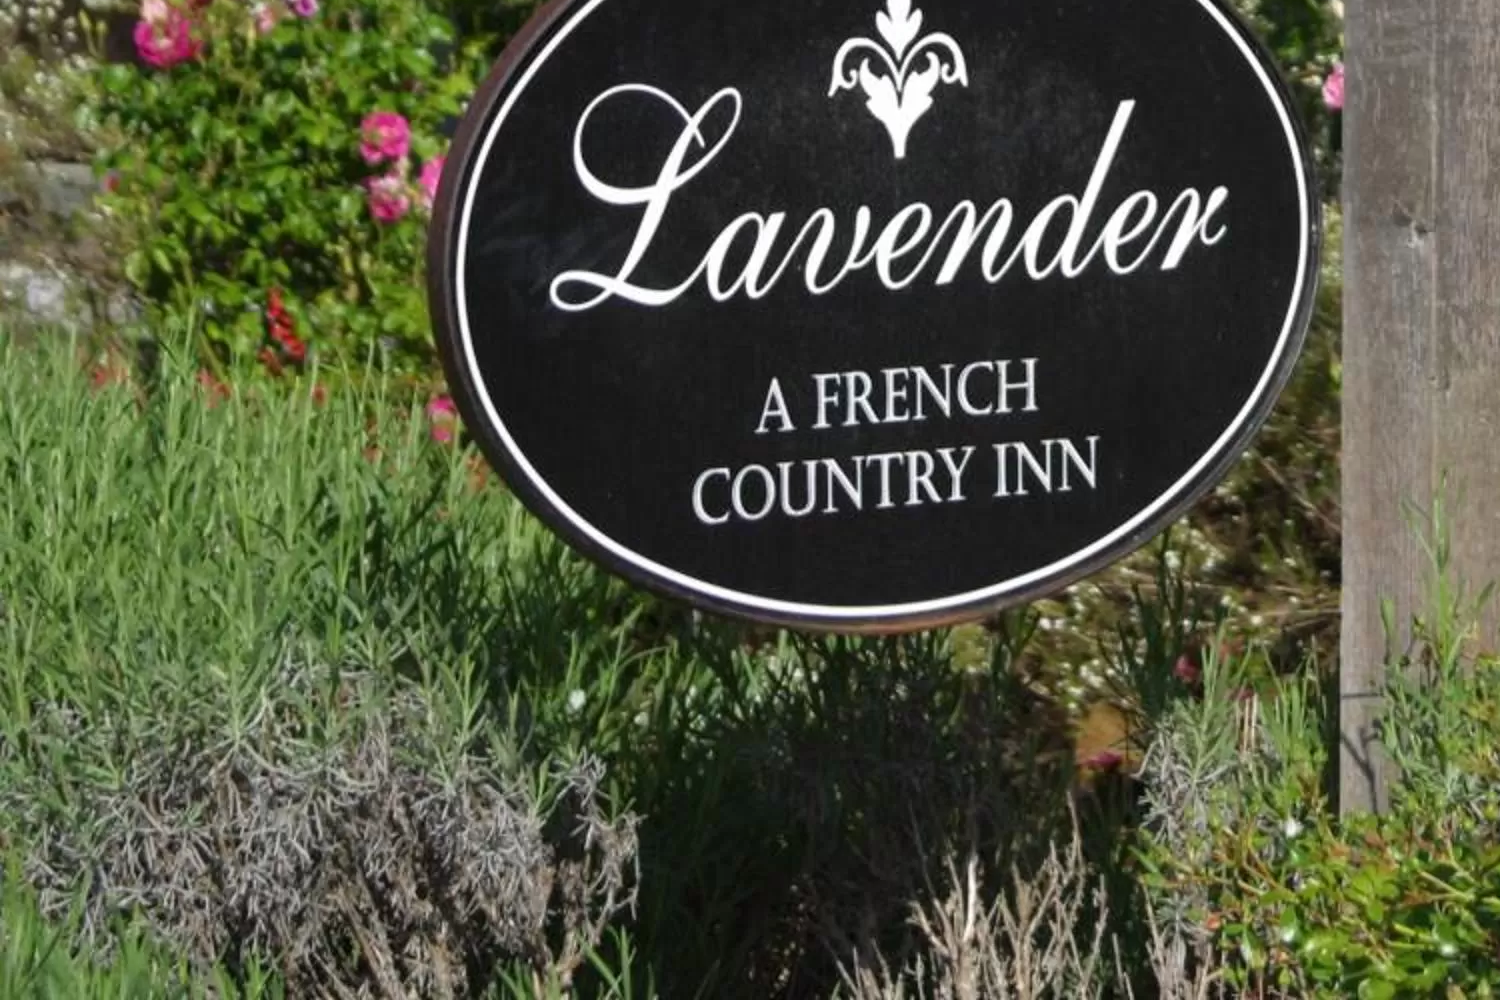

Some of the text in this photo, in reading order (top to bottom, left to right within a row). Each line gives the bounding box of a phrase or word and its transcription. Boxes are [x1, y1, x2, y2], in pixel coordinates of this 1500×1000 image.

[549, 83, 1230, 312] Lavender
[753, 357, 1039, 434] A FRENCH
[691, 435, 1102, 526] COUNTRY INN
